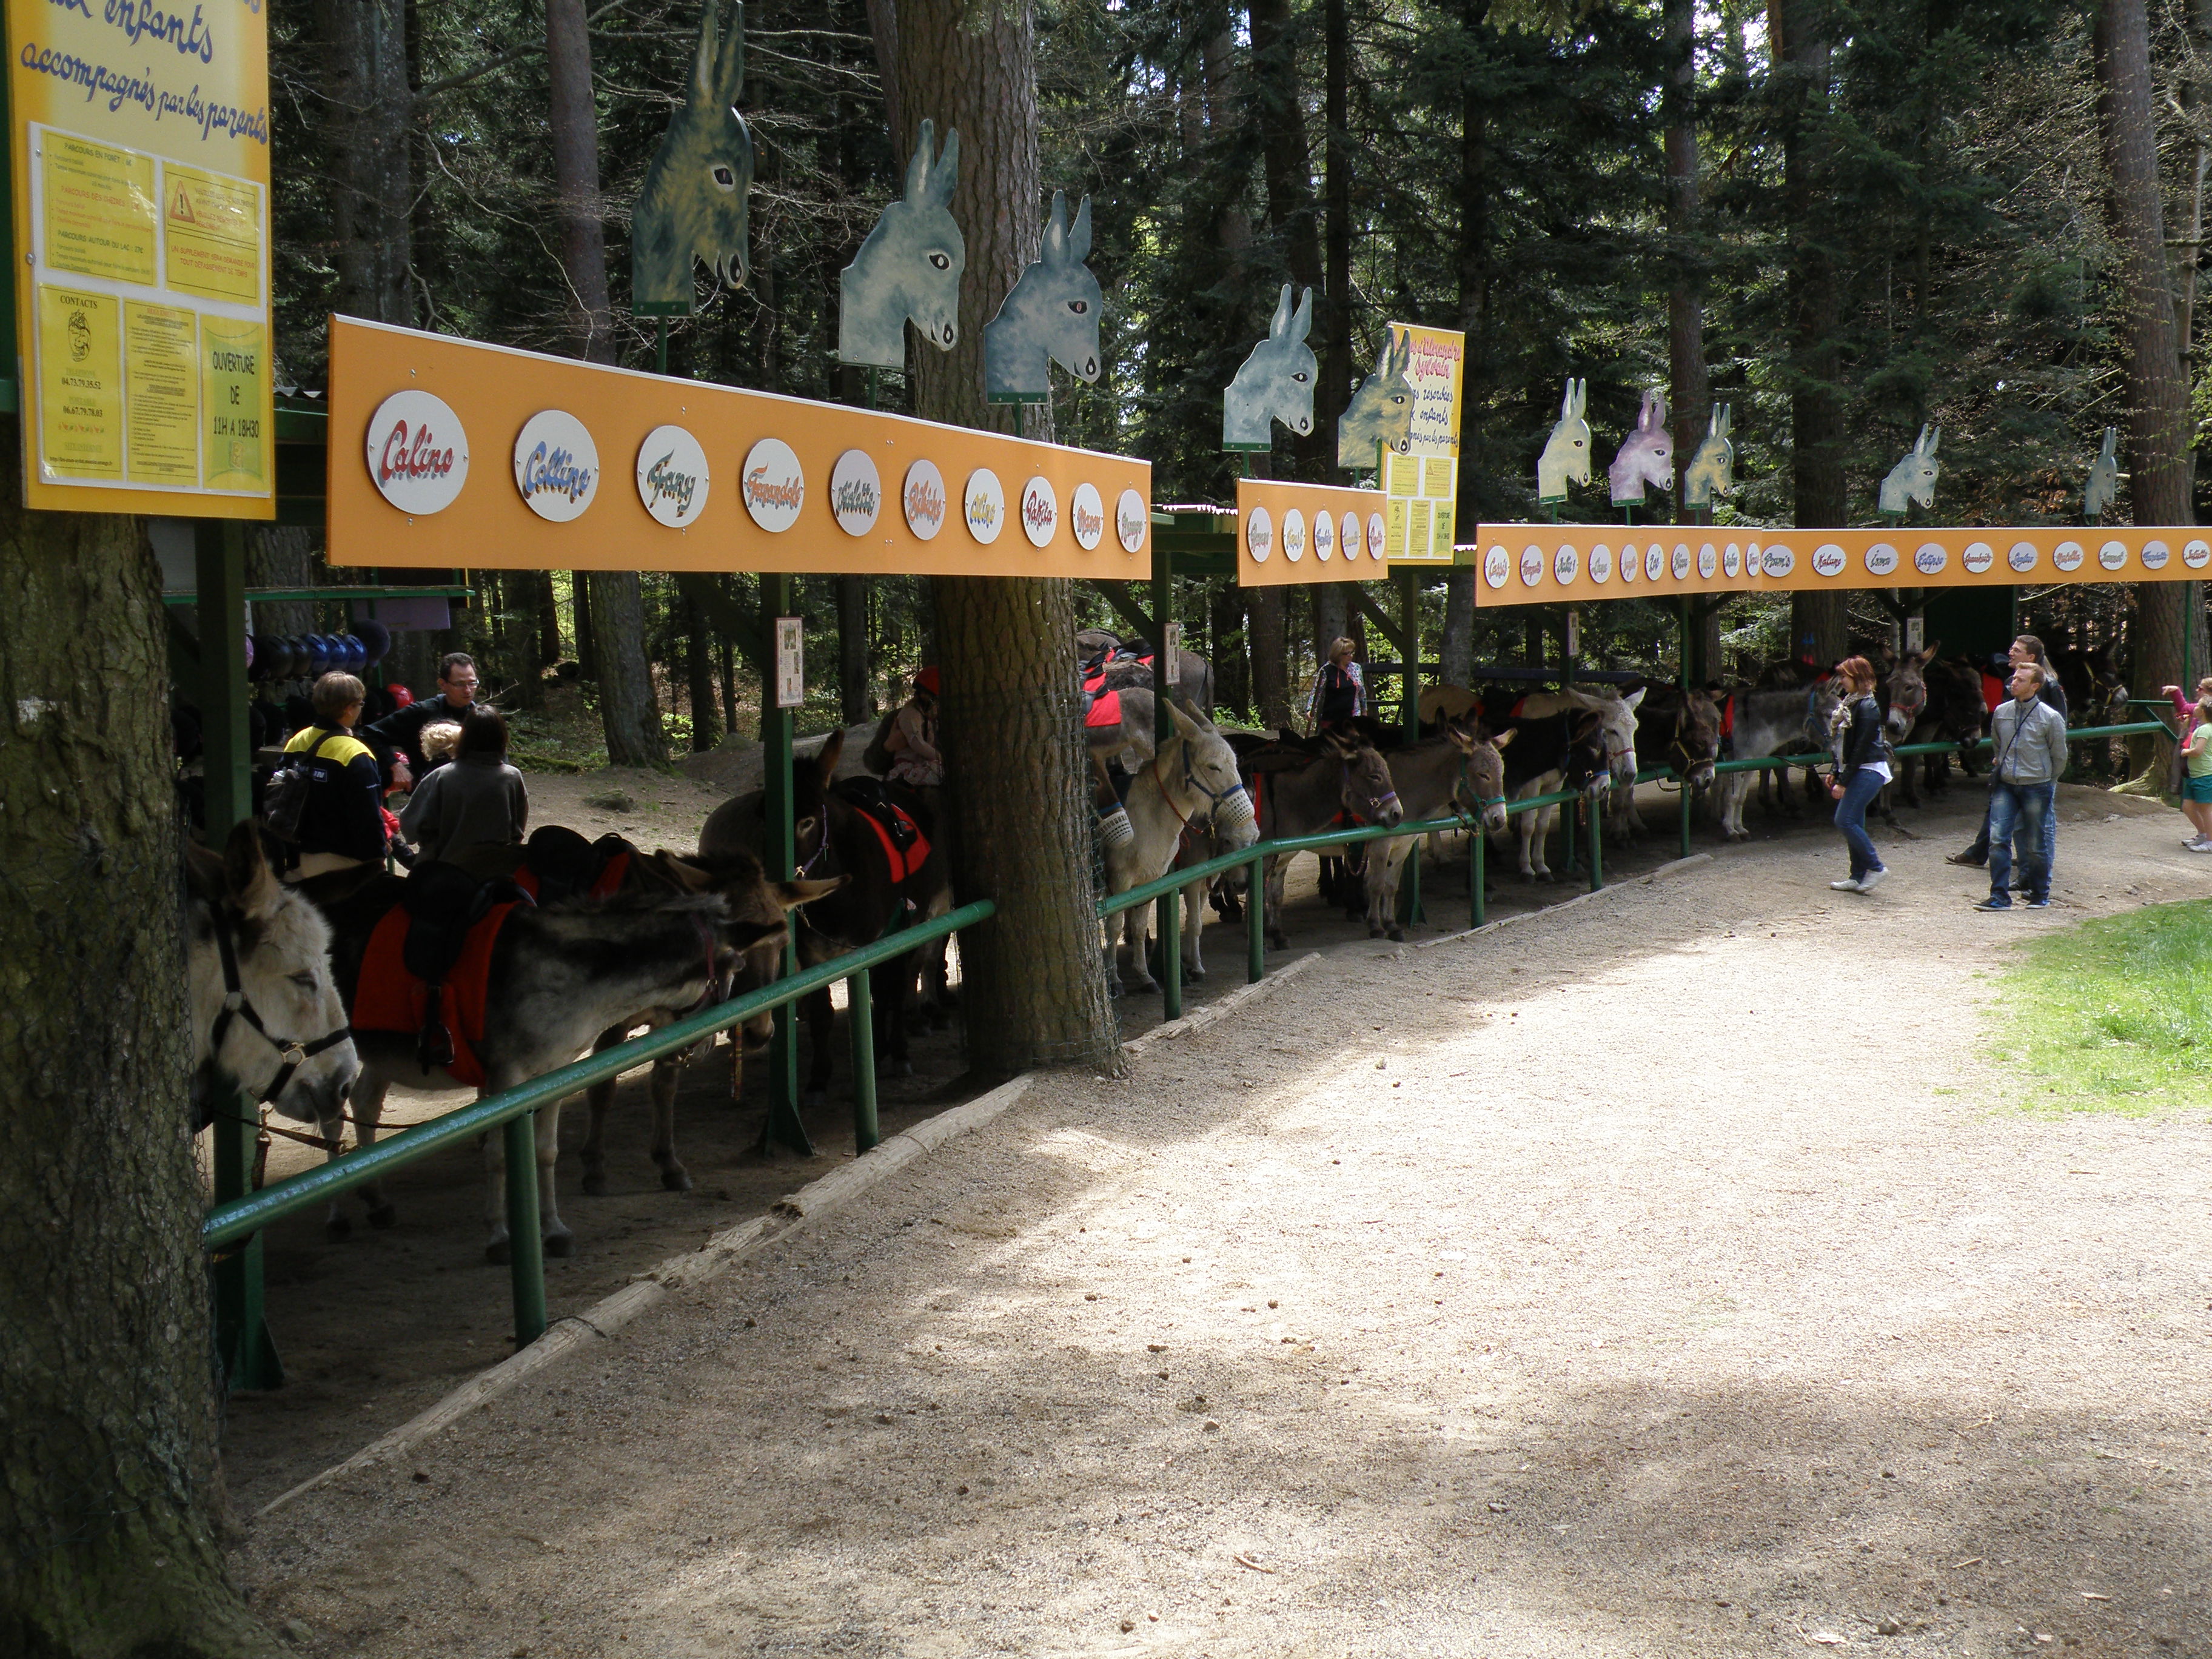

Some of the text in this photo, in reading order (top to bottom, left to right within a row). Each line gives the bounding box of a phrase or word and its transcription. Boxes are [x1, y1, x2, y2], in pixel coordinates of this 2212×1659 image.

[104, 0, 212, 64] enfants
[21, 42, 269, 145] accompagnés par les parents
[58, 229, 87, 243] PARCOURS
[60, 295, 98, 309] CONTACTS
[212, 350, 255, 375] OUVERTURE
[230, 385, 240, 406] DE
[213, 416, 259, 438] 11H A 18H30
[1419, 406, 1449, 426] enfants
[1026, 489, 1053, 532] Pakita
